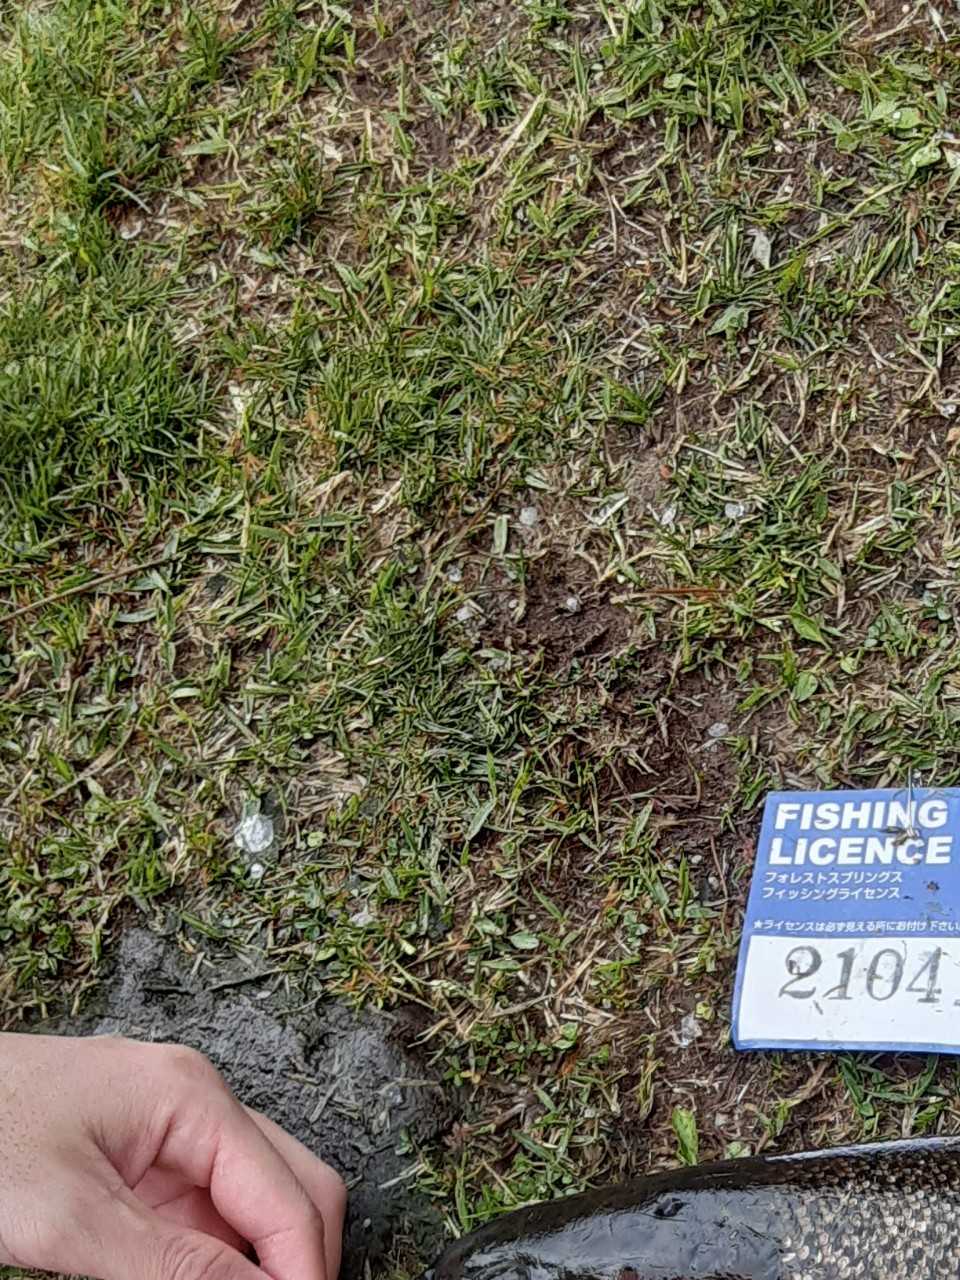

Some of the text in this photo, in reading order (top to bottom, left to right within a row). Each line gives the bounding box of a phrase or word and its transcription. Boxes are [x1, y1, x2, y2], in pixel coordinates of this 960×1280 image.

[774, 800, 949, 830] FISHING
[768, 836, 953, 866] LICENCE
[765, 871, 902, 884] フォレストスプリングス
[763, 888, 901, 900] フィッシングライセンス
